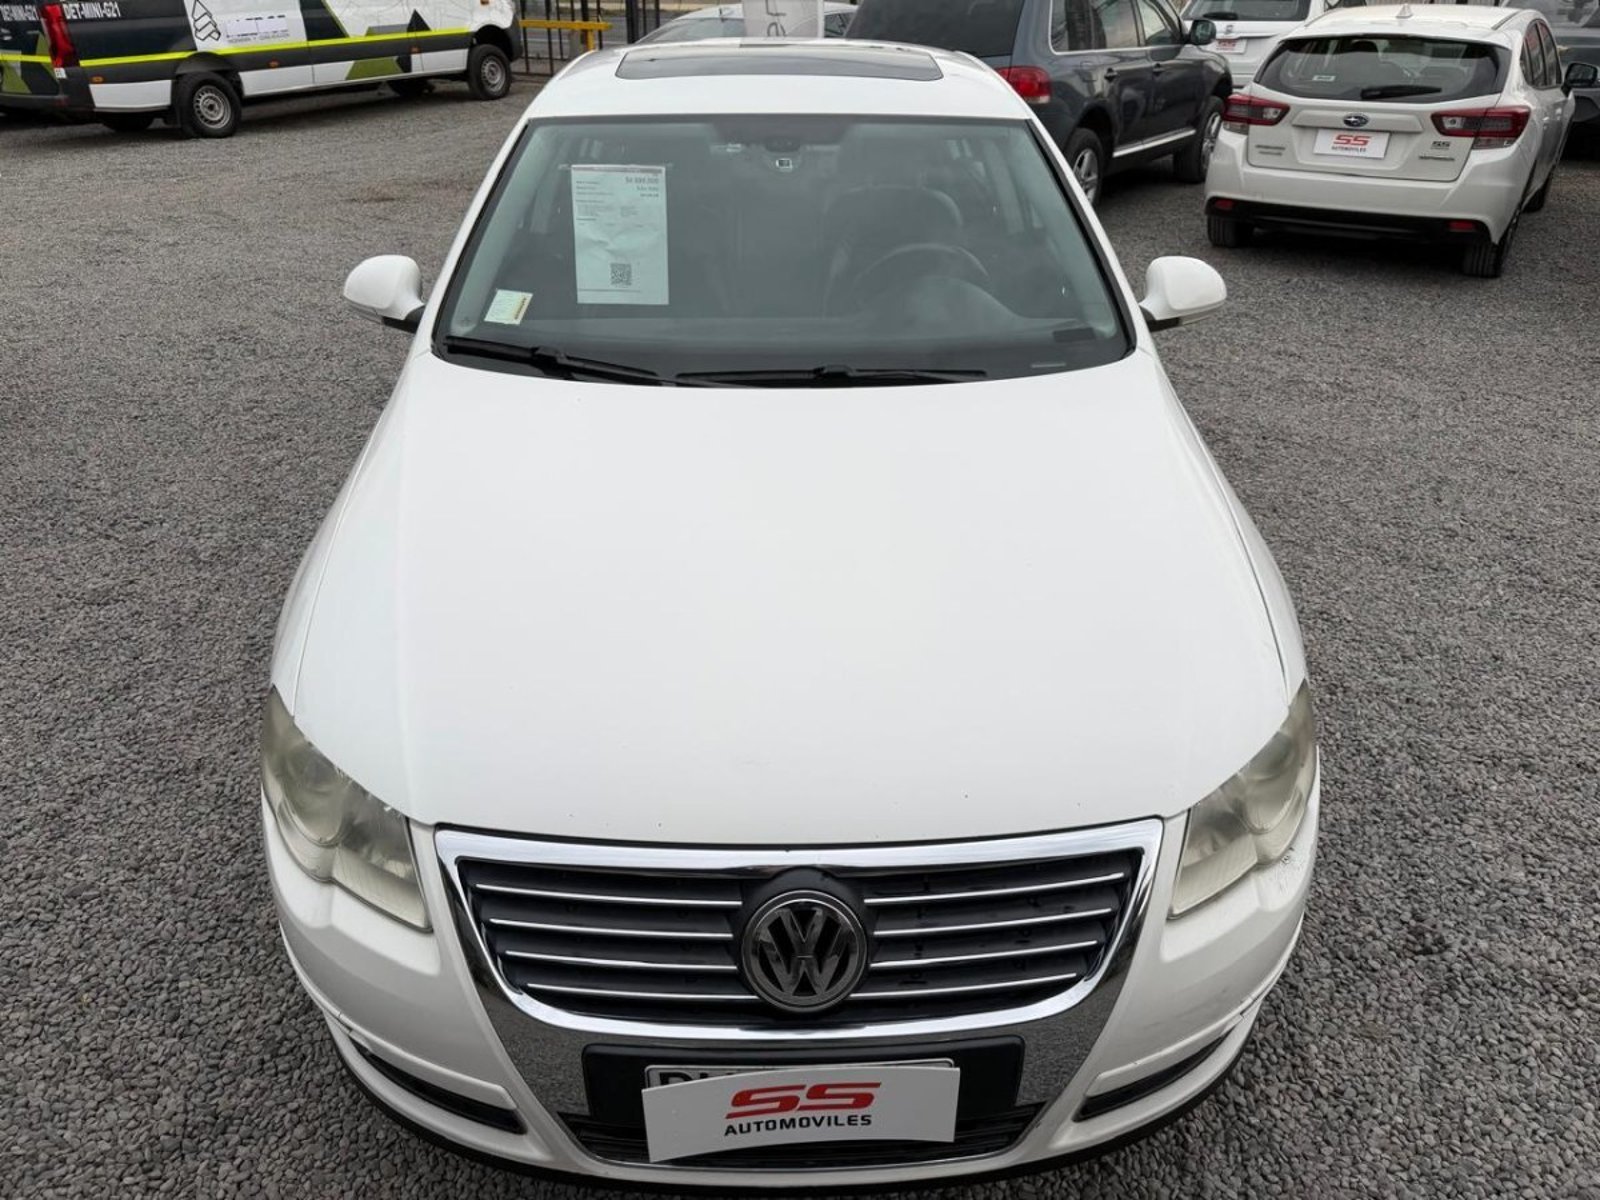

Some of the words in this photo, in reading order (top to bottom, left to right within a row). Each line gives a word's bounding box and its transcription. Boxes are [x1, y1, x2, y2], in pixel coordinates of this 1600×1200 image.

[61, 1, 121, 19] DET-MINI-G21
[1333, 134, 1372, 146] SS
[725, 1082, 881, 1119] SS
[724, 1114, 872, 1136] AUTOMOVILES
